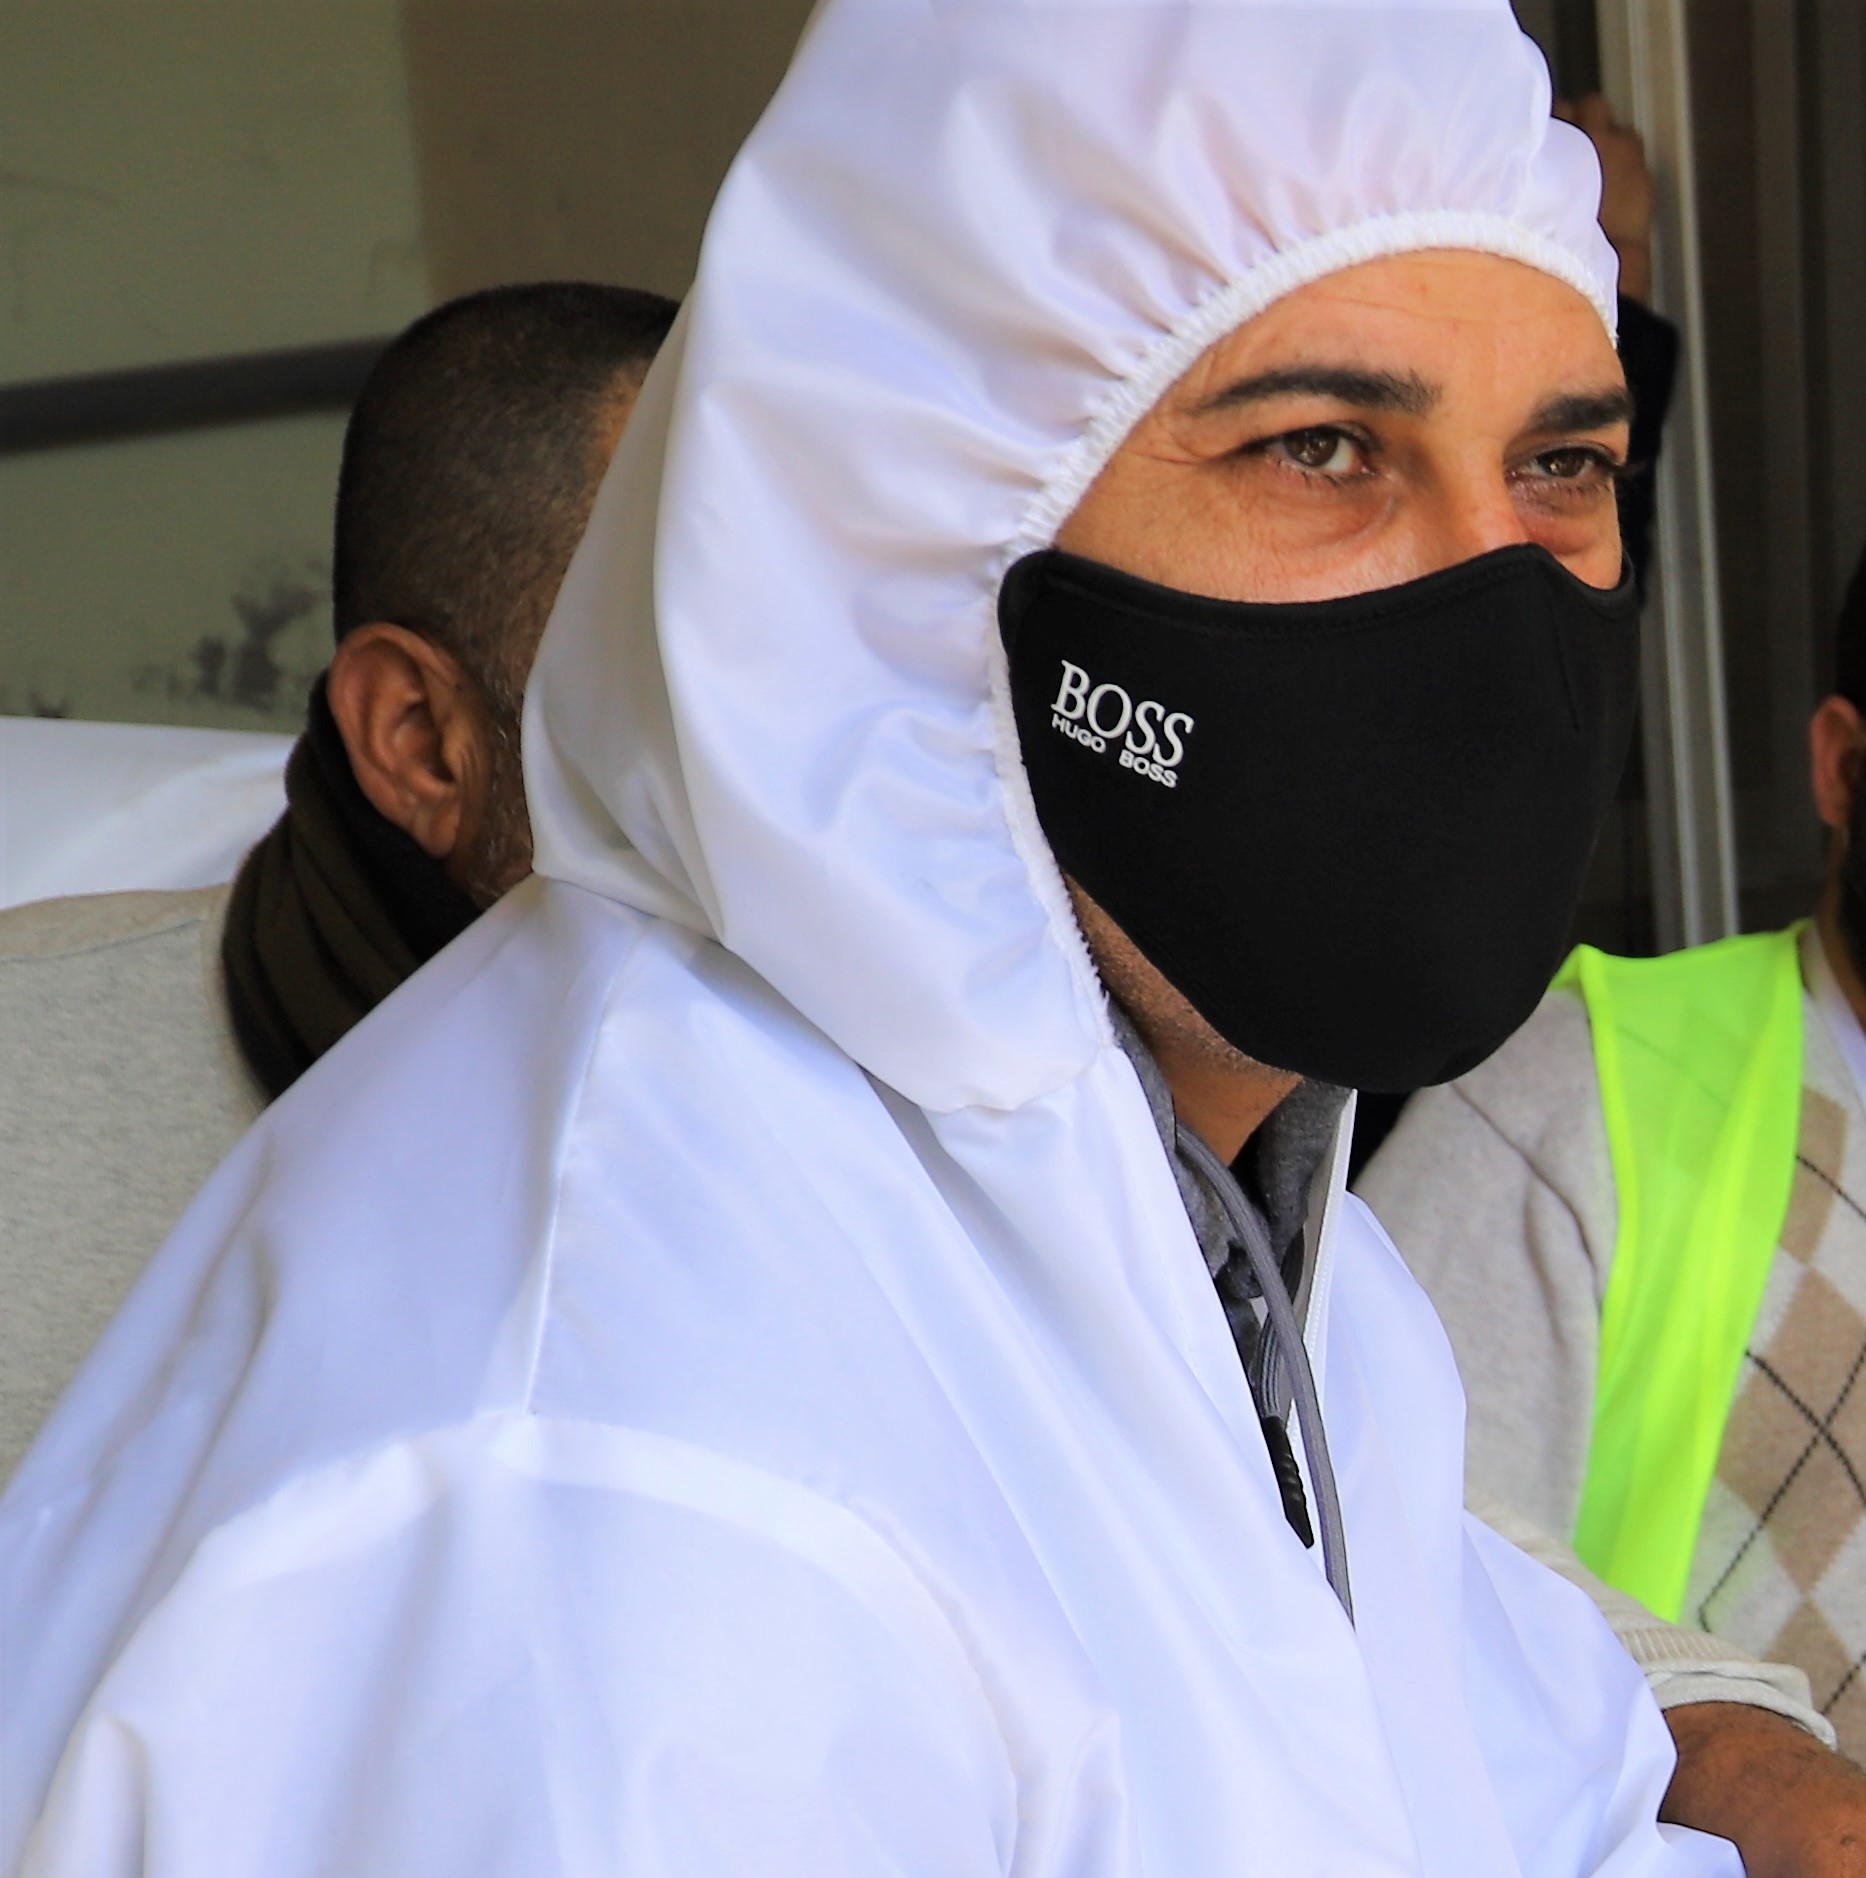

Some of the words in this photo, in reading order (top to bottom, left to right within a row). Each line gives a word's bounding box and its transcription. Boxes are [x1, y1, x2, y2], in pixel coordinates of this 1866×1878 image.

[1051, 659, 1194, 767] BOSS
[1051, 713, 1106, 753] HUGO
[1118, 748, 1178, 788] BOSS
